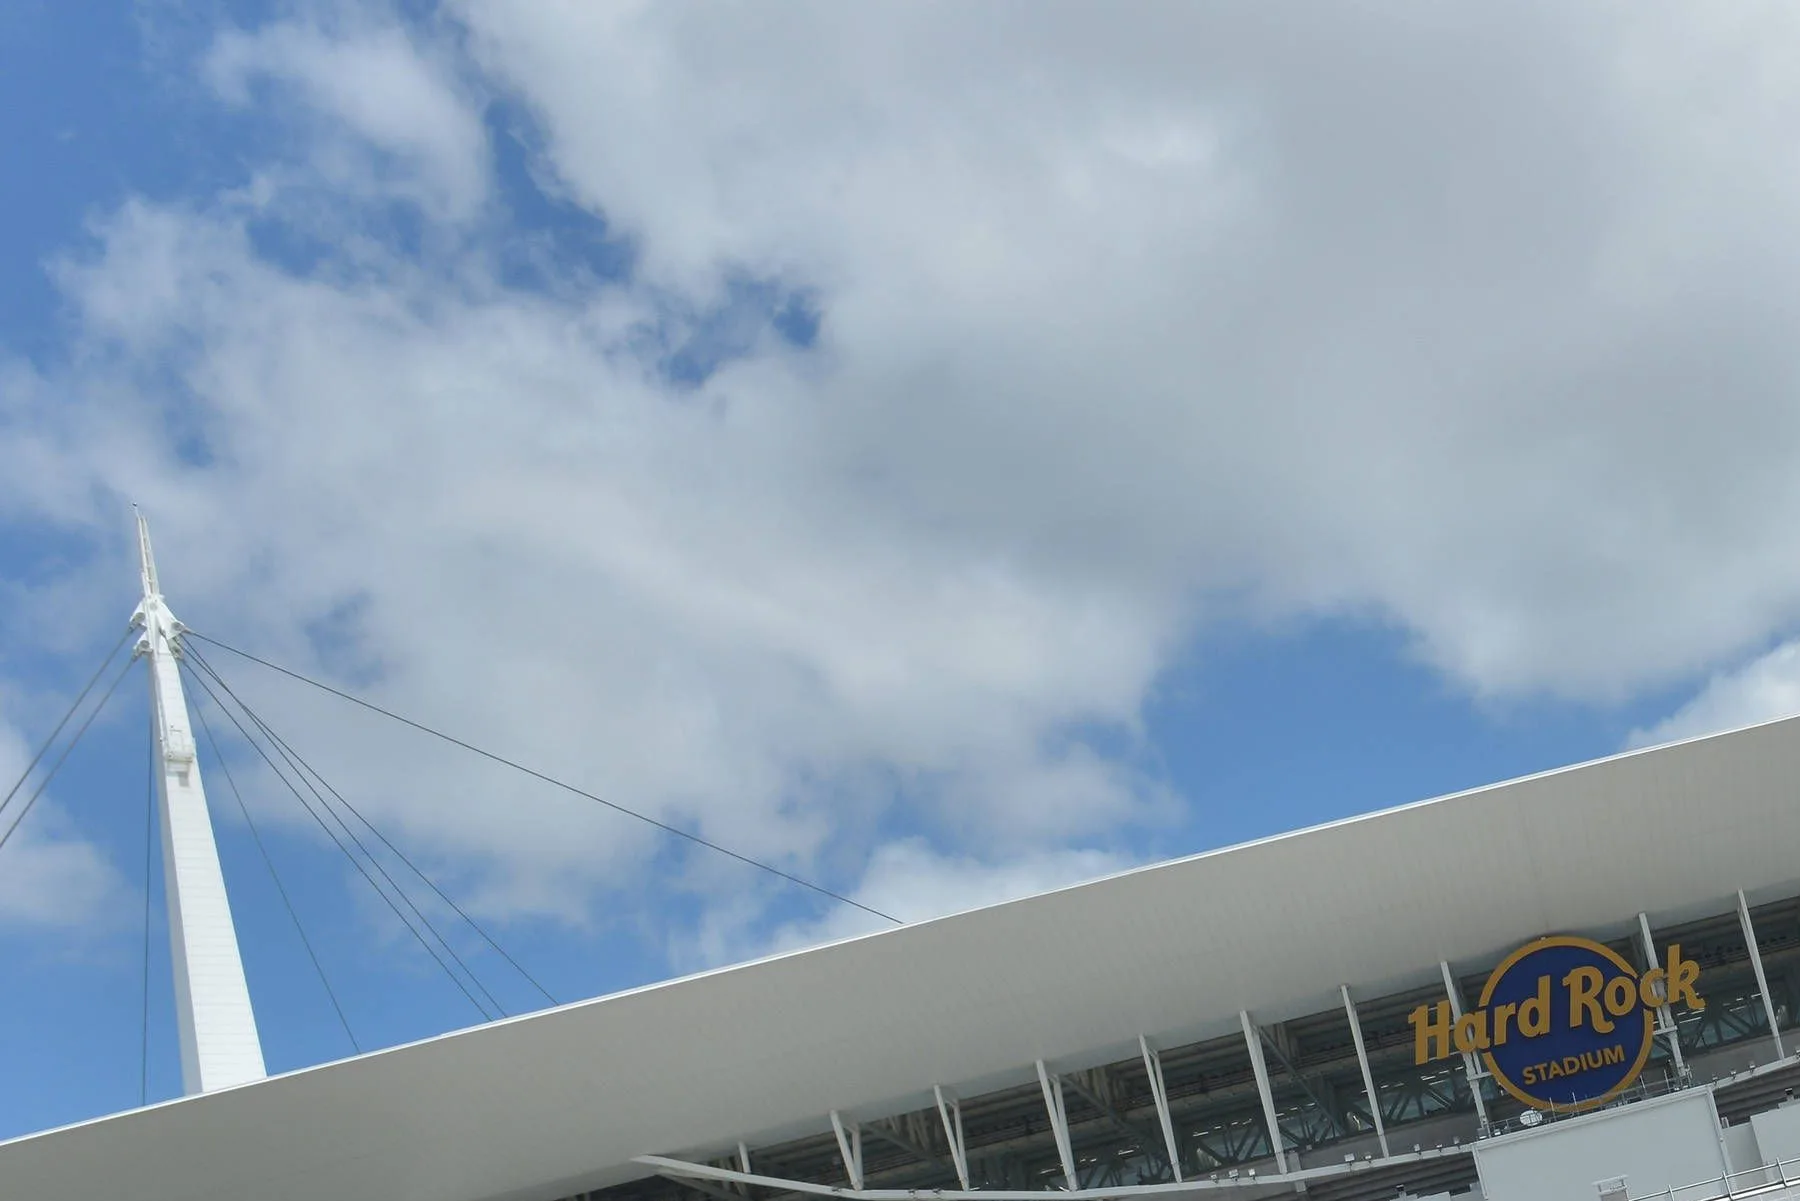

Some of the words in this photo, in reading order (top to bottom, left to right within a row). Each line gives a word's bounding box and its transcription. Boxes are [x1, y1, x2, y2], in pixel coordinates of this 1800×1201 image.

[1408, 974, 1551, 1065] Hard
[1562, 944, 1706, 1034] Rock
[1521, 1045, 1625, 1086] STADIUM
